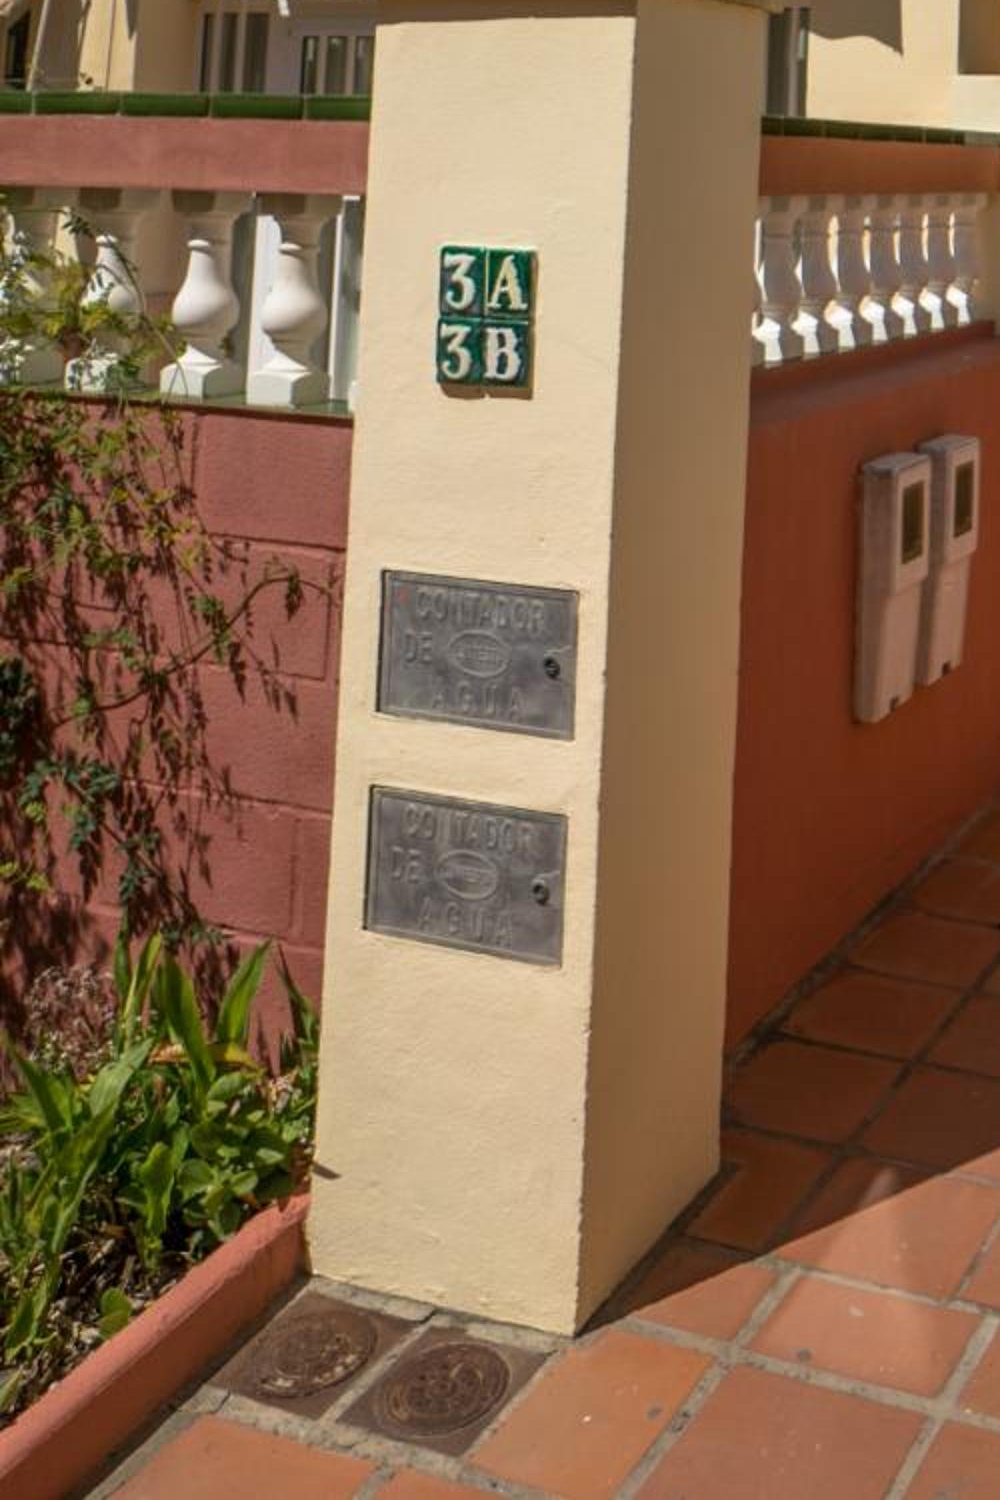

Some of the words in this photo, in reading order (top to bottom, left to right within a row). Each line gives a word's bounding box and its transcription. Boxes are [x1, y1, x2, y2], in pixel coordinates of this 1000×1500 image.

[443, 253, 528, 311] 3A
[439, 323, 521, 380] 3B
[417, 586, 545, 634] CONTADOR
[404, 629, 432, 664] DE
[432, 679, 526, 723] AGUA
[391, 845, 420, 884] DE
[417, 897, 512, 948] AGUA
